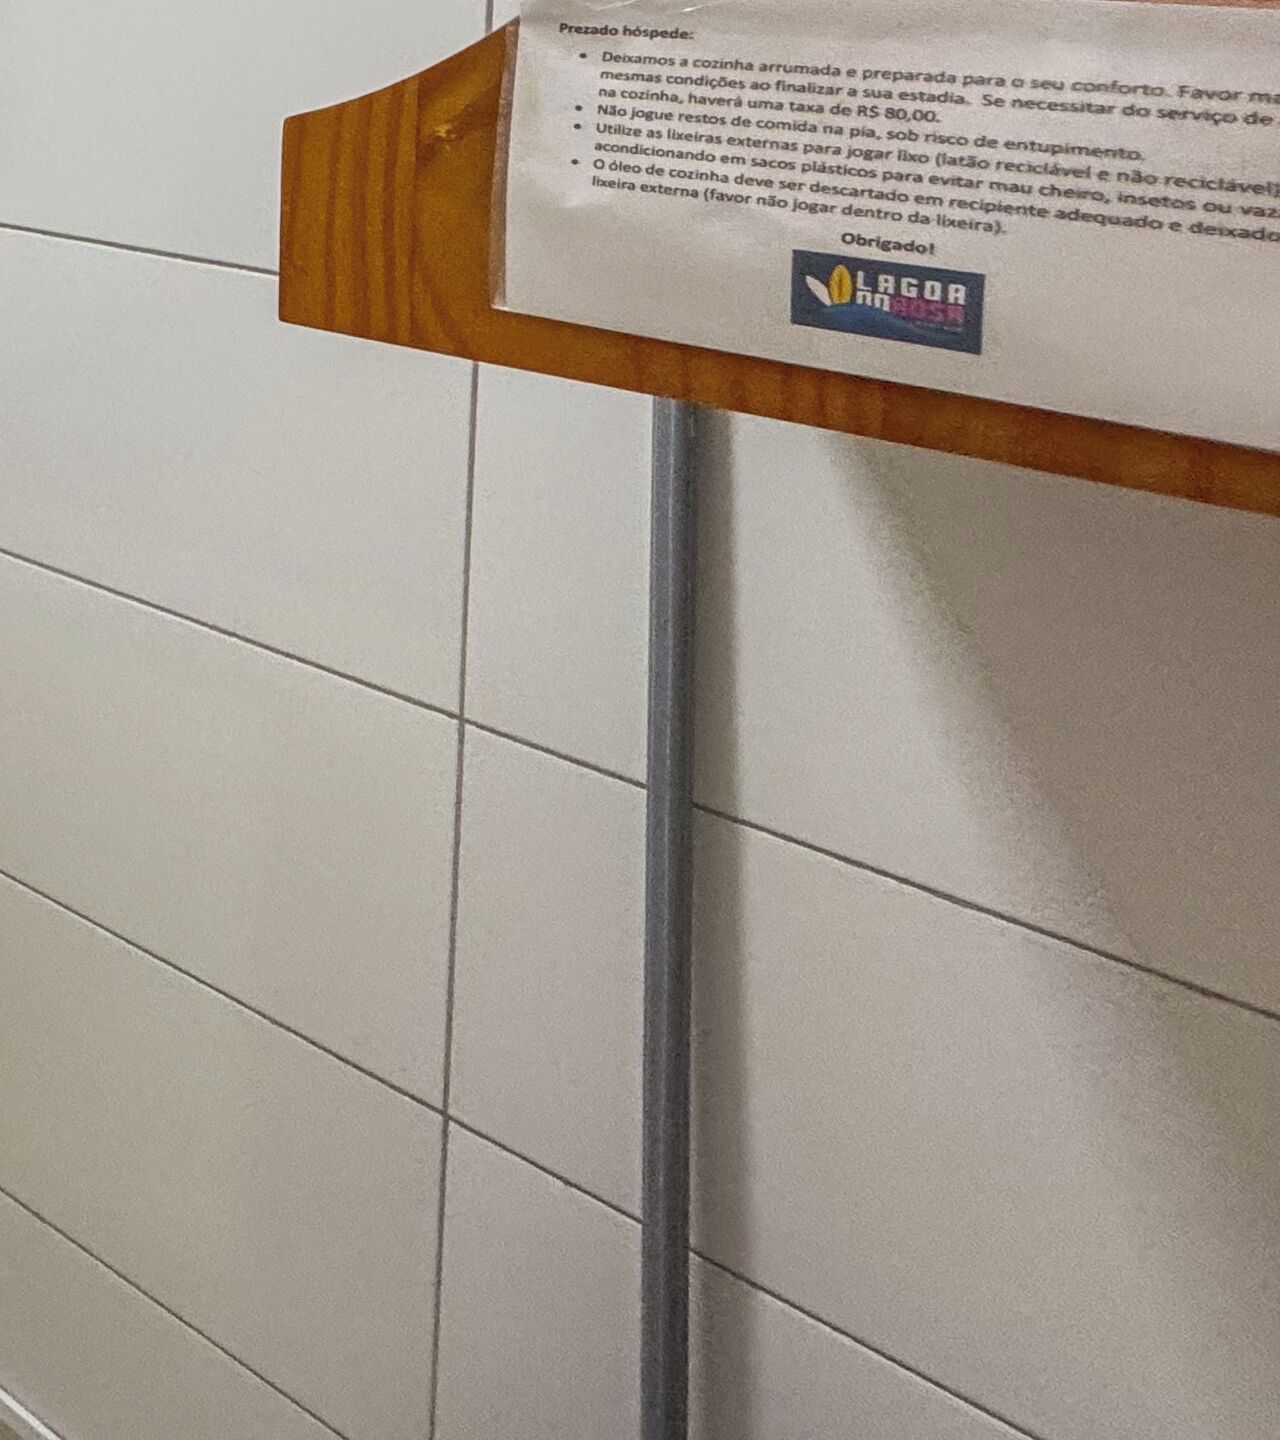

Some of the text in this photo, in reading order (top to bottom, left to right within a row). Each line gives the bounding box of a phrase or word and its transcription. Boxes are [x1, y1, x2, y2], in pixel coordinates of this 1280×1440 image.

[559, 23, 694, 40] Prezado hóspede:
[600, 69, 1274, 126] mesmas condições ao finalizar a sua estadia. Se necessitar do serviço de
[602, 51, 675, 66] Deixamos
[680, 59, 688, 67] a
[692, 58, 754, 71] cozinha
[759, 63, 841, 77] arrumada
[846, 69, 857, 78] e
[862, 68, 956, 84] preparada
[962, 73, 1006, 88] para
[1011, 78, 1024, 88] o
[1030, 78, 1064, 91] seu
[1178, 85, 1243, 101] Favor
[597, 103, 1144, 161] Não jogue restos de comida na pia, sob risco de entupimento.
[599, 87, 617, 98] na
[621, 89, 684, 104] cozinha,
[688, 93, 743, 108] haverá
[747, 101, 784, 111] uma
[790, 101, 825, 114] taxa
[829, 103, 853, 116] de
[884, 108, 940, 123] 80,00.
[594, 141, 716, 162] acondicionando
[720, 154, 746, 165] em
[750, 157, 796, 171] sacos
[801, 160, 877, 178] plásticos
[882, 169, 923, 183] para
[928, 174, 984, 189] evitar
[989, 180, 1032, 194] mau
[1038, 184, 1111, 204] cheiro,
[1117, 191, 1196, 210] insetos
[1202, 201, 1232, 214] ou
[596, 122, 642, 138] Utilize
[646, 128, 662, 139] as
[667, 128, 722, 145] lixeiras
[726, 136, 798, 152] externas
[803, 141, 841, 156] para
[847, 145, 892, 161] jogar
[897, 149, 930, 164] lixo
[936, 152, 990, 170] (latão
[995, 159, 1092, 179] reciclável
[1097, 169, 1110, 181] e
[1117, 170, 1158, 185] não
[592, 175, 1006, 236] lixeira externa (favor não jogar dentro da lixeira).
[593, 159, 605, 170] O
[608, 159, 641, 174] óleo
[645, 163, 665, 176] de
[669, 168, 729, 184] cozinha
[734, 173, 774, 189] deve
[778, 180, 806, 192] ser
[809, 181, 909, 203] descartado
[914, 194, 944, 207] em
[949, 195, 1050, 218] recipiente
[1055, 209, 1164, 230] adequado
[1168, 220, 1183, 232] e
[841, 233, 936, 255] Obrigado!
[856, 270, 966, 305] LAGOA
